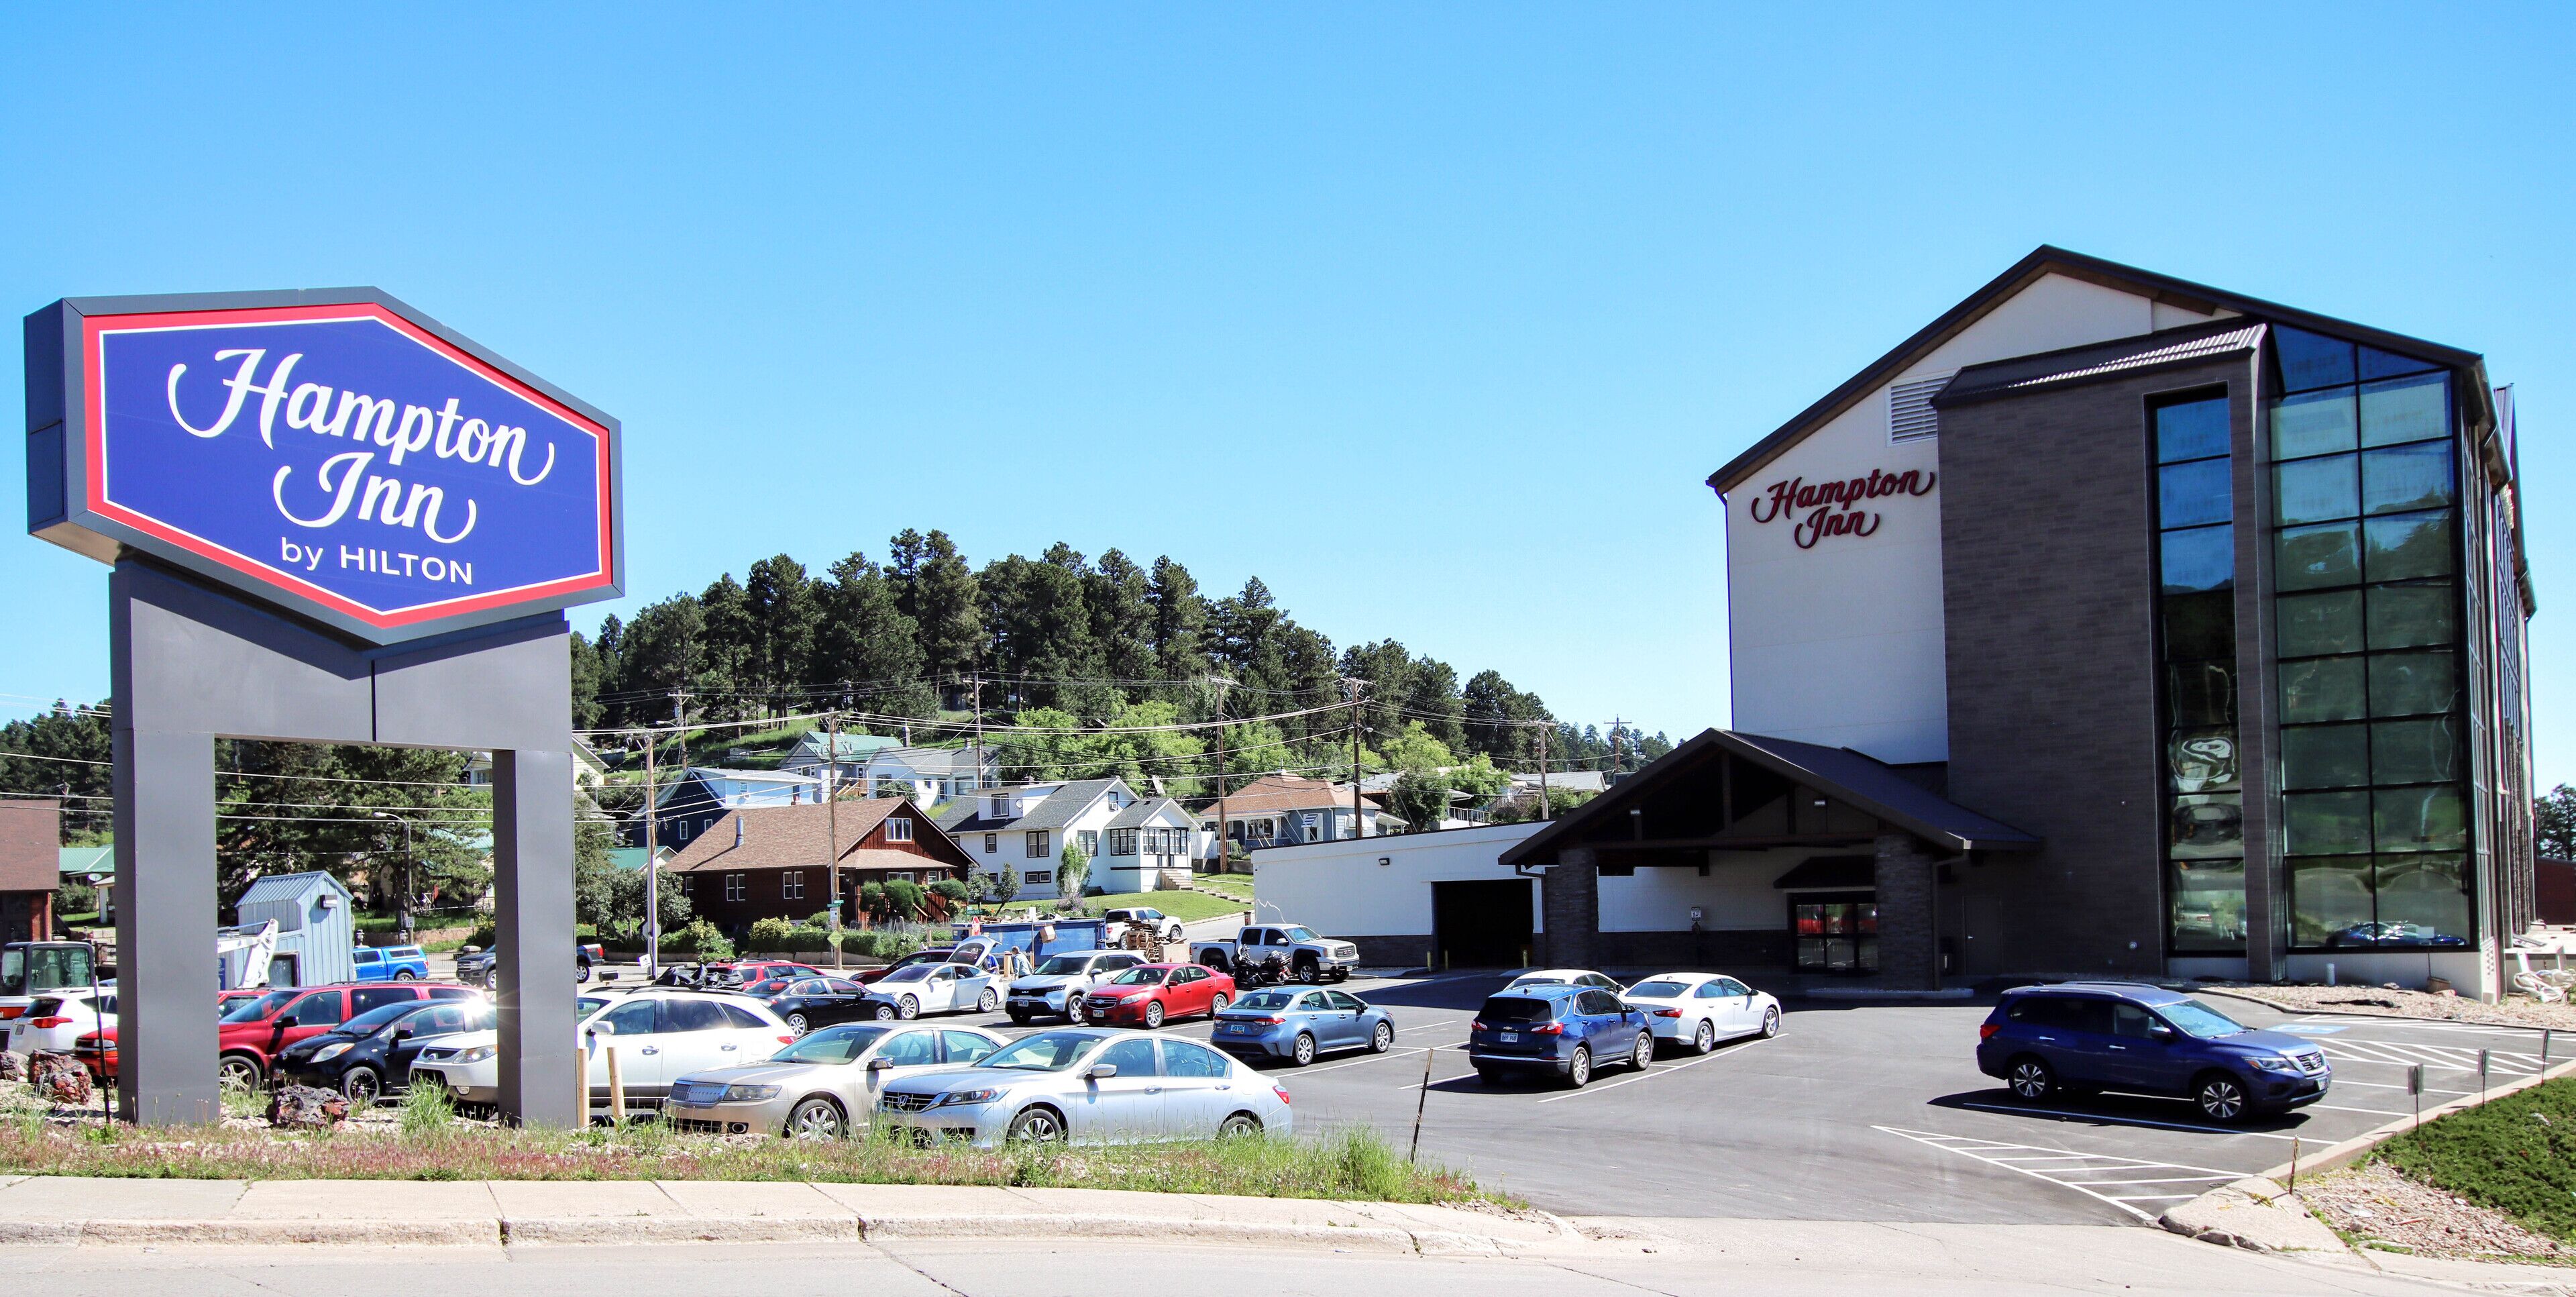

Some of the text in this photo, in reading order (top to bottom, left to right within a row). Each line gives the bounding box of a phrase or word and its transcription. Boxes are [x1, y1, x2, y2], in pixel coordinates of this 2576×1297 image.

[167, 348, 555, 486] Hampton
[273, 452, 477, 543] Inn
[1751, 468, 1936, 524] Hampton
[1794, 505, 1881, 550] Inn
[281, 536, 473, 586] by HILTON
